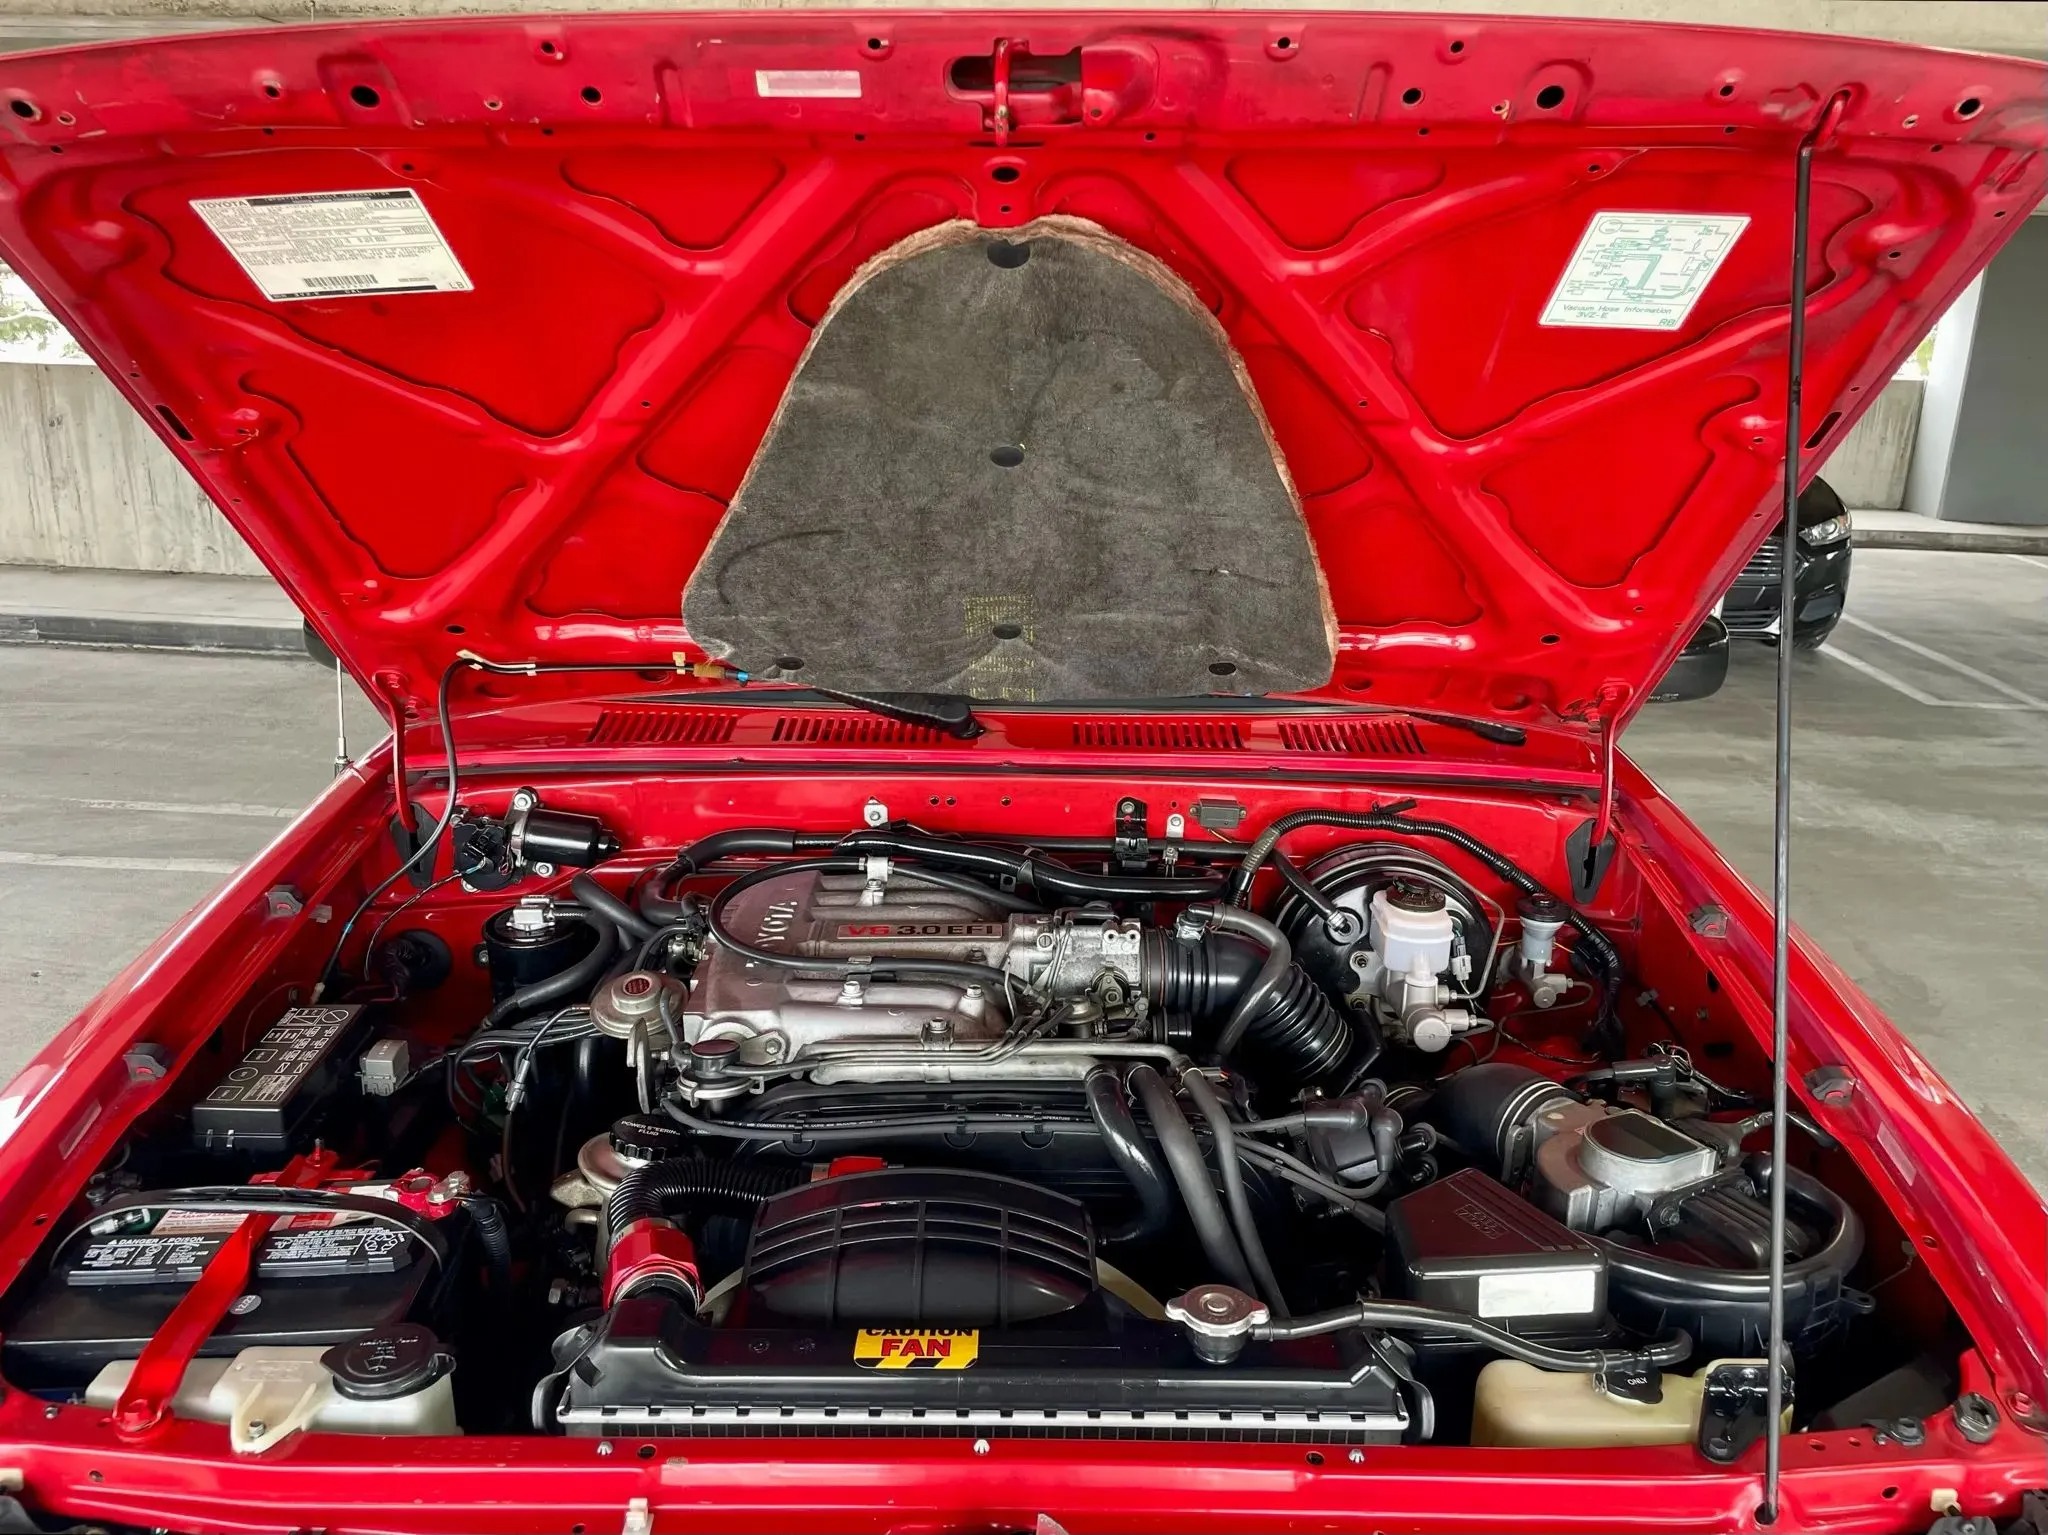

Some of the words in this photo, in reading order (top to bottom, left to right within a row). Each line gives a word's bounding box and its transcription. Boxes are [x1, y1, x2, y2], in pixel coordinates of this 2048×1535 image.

[200, 200, 248, 209] TOYOTA
[367, 199, 418, 209] CATALYST
[1563, 304, 1595, 312] Vacuum
[1623, 306, 1672, 314] Information
[1576, 311, 1609, 319] 3VZ-E
[848, 925, 890, 936] V6
[897, 925, 941, 935] 3.0
[947, 925, 993, 935] EFI
[621, 1120, 647, 1129] POWER
[638, 1128, 660, 1136] FLUID
[881, 1338, 952, 1357] FAN
[1627, 1377, 1648, 1386] ONLY
